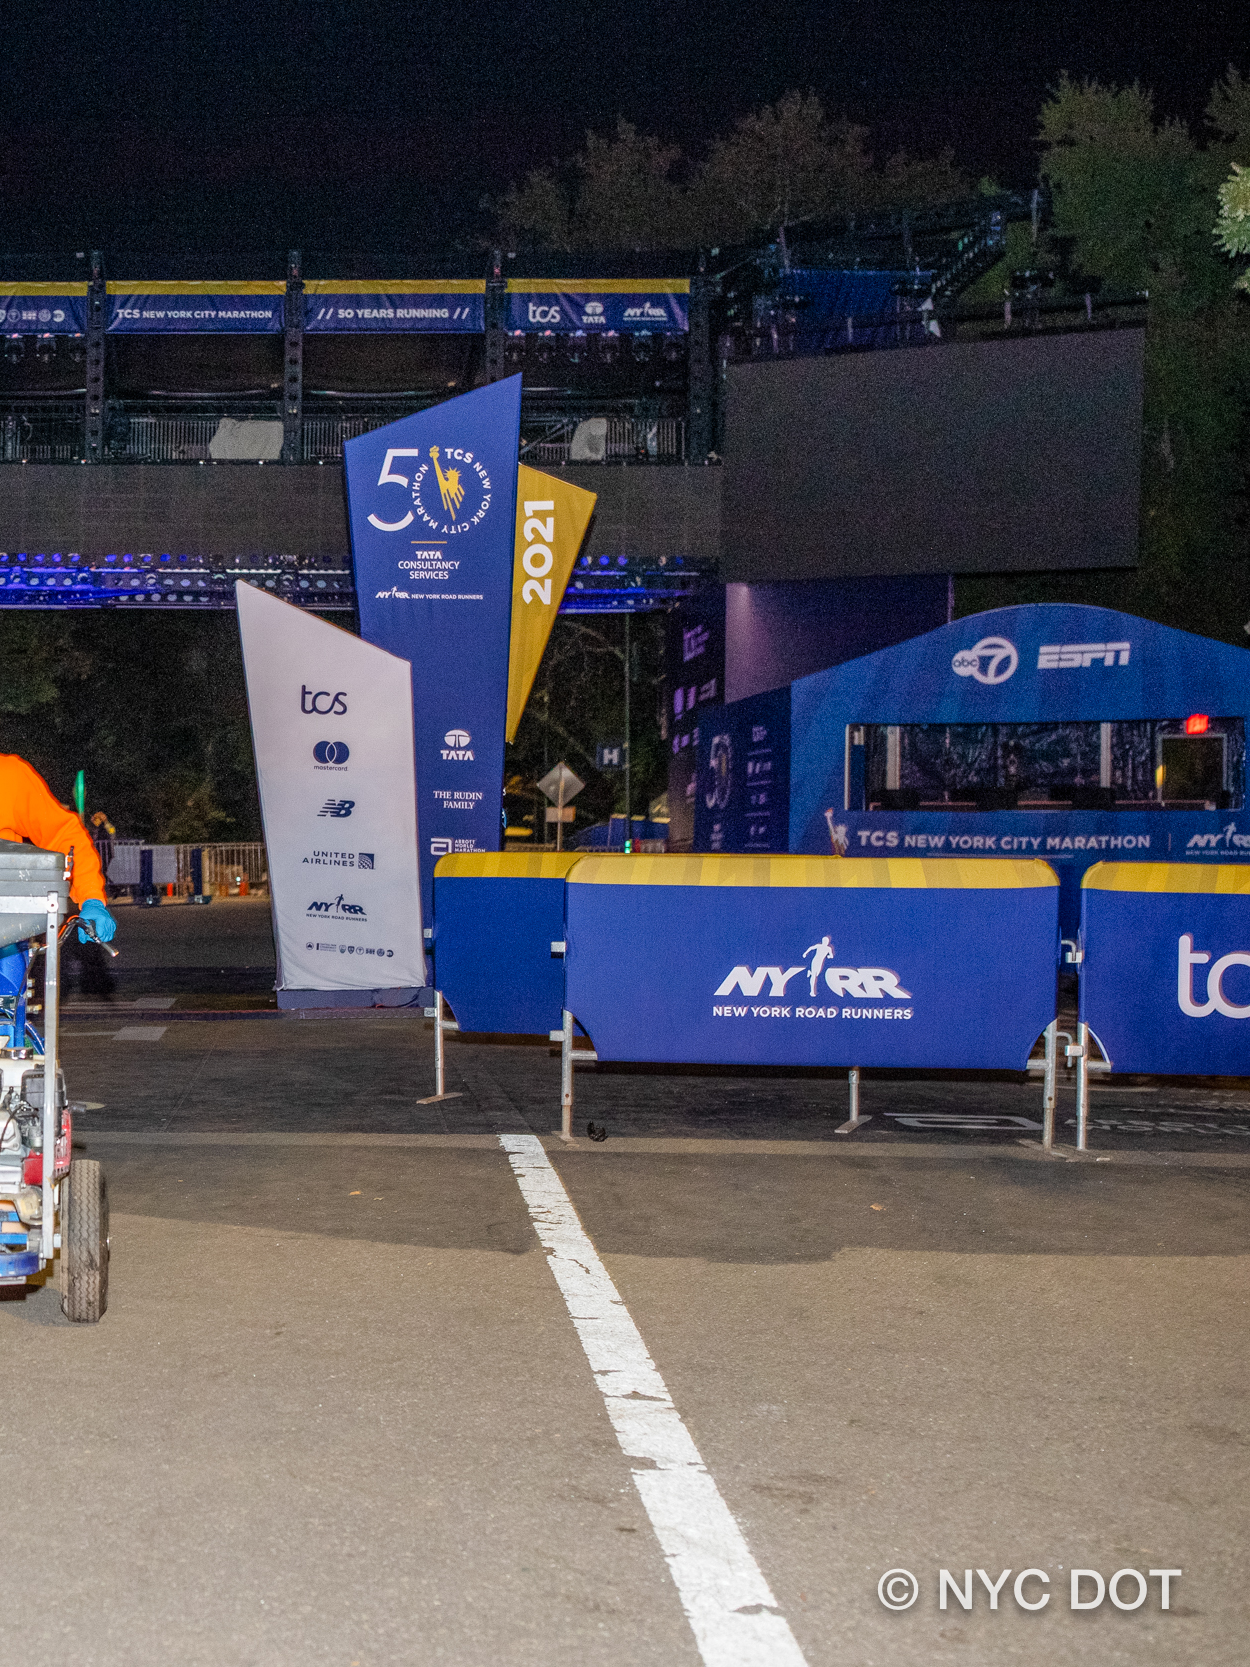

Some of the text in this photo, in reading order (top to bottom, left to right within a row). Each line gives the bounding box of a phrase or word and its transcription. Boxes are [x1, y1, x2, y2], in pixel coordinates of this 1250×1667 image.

[117, 309, 272, 319] TCS NEW YORK CITY MARATHON
[356, 309, 394, 318] YEARS
[396, 308, 449, 318] RUNNING
[529, 302, 561, 323] tcs
[582, 315, 606, 324] TATA
[412, 448, 492, 534] TCS NEW YORK CITY MARATHON
[416, 551, 442, 560] TATA
[522, 500, 555, 605] 2021
[398, 561, 460, 570] CONSULTANCY
[409, 571, 449, 580] SERVICES
[952, 658, 978, 668] abc
[1037, 641, 1130, 670] ESPN
[301, 684, 348, 715] tcs
[440, 750, 474, 761] TATA
[433, 790, 483, 800] THE RUDIN
[443, 800, 475, 810] FAMILY
[858, 830, 1150, 850] TCS NEW YORK CITY MARATHON
[313, 851, 355, 860] UNITED
[302, 857, 355, 867] AIRLINES
[712, 1005, 912, 1020] NEW YORK ROAD RUNNERS
